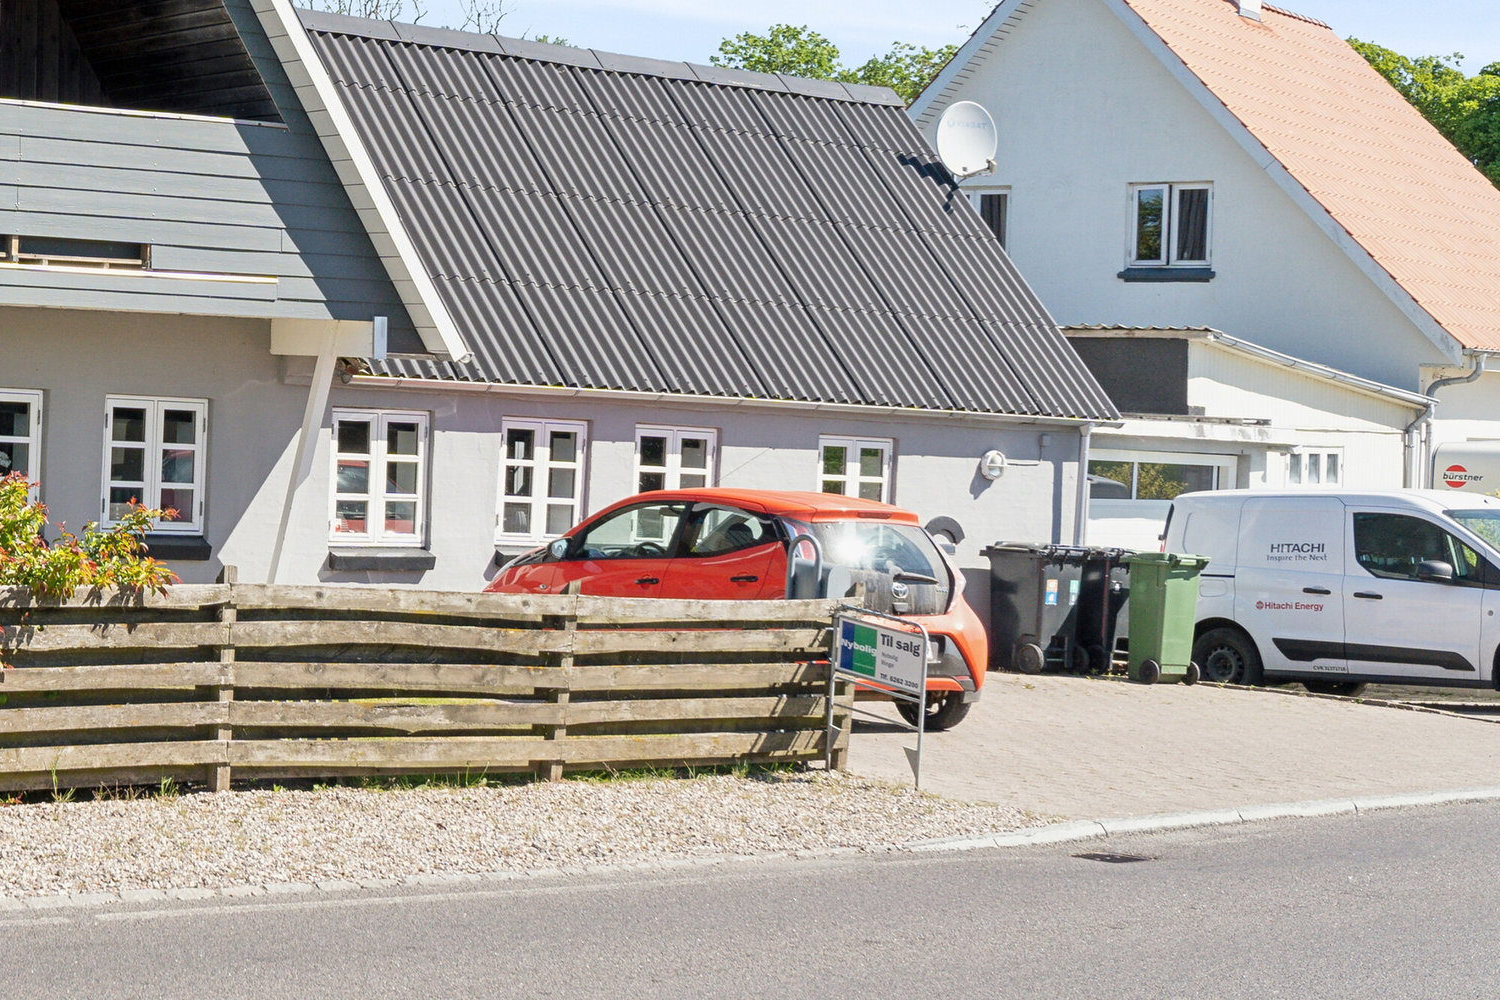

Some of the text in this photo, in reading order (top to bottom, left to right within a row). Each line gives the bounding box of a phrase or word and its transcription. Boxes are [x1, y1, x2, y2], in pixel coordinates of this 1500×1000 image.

[1443, 472, 1483, 481] bürstner
[1270, 543, 1325, 553] HITACHI
[1266, 554, 1293, 562] Inspire
[1309, 553, 1328, 561] Next
[1264, 602, 1324, 612] Hitachi Energy
[841, 638, 878, 657] Nybolig
[880, 633, 921, 657] Til salg
